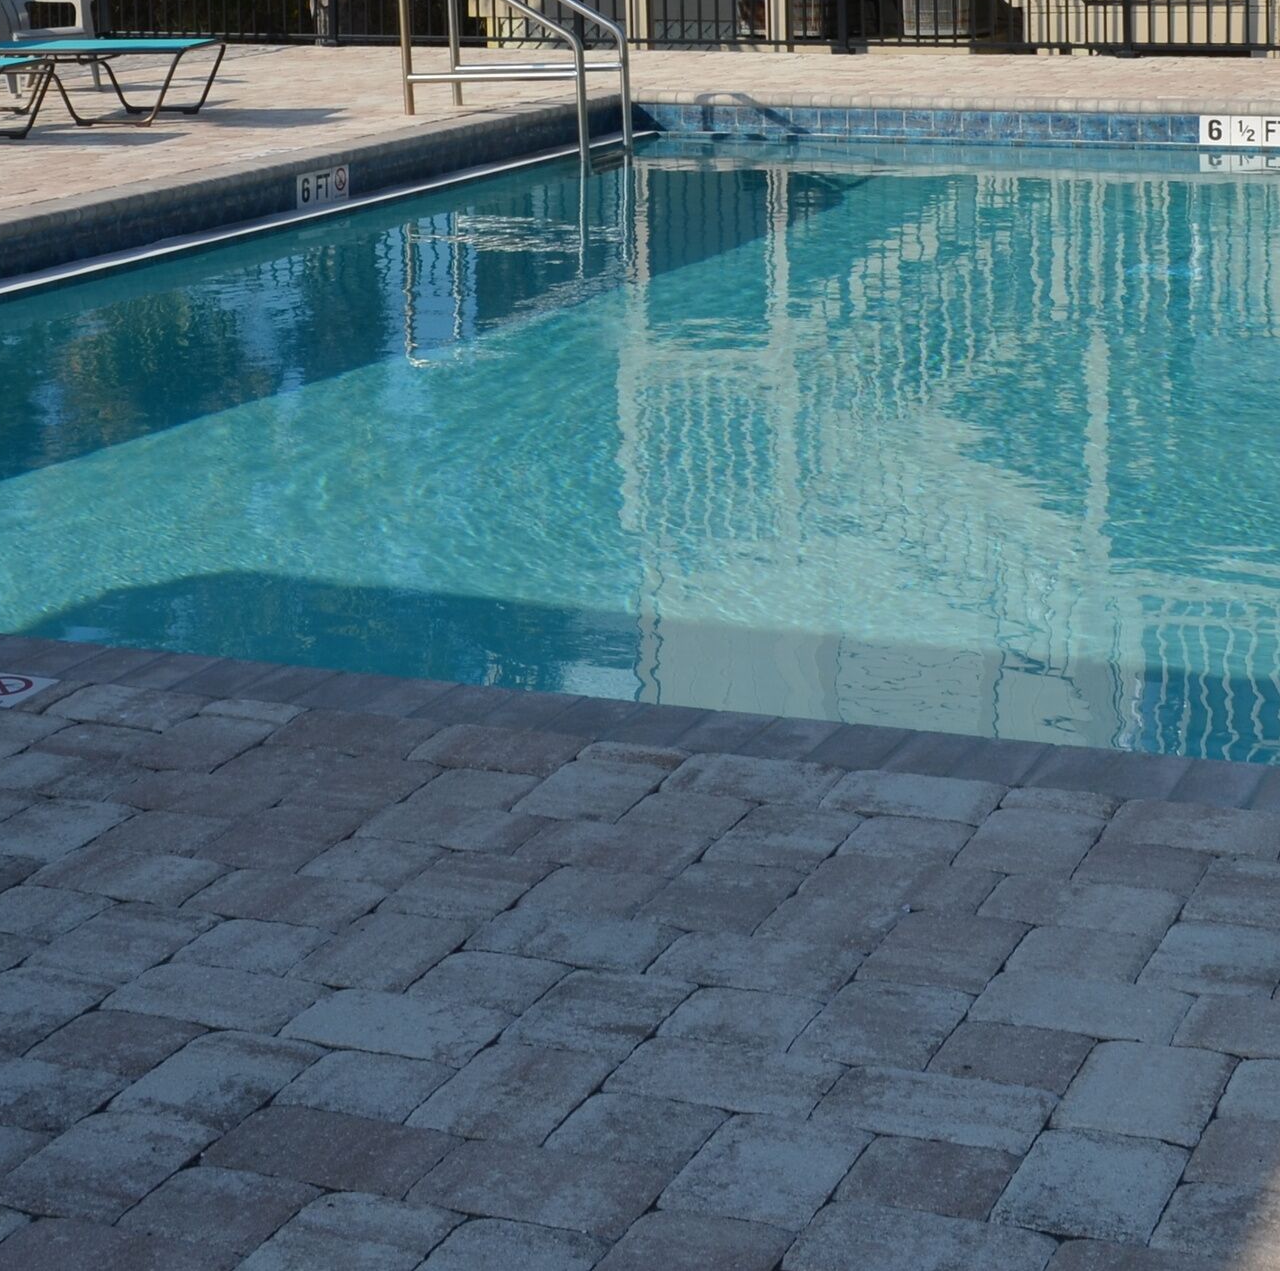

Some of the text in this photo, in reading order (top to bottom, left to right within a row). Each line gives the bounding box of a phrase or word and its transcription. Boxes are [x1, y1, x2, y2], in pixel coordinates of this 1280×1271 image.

[1208, 119, 1222, 140] 6
[302, 173, 330, 203] 6 FT
